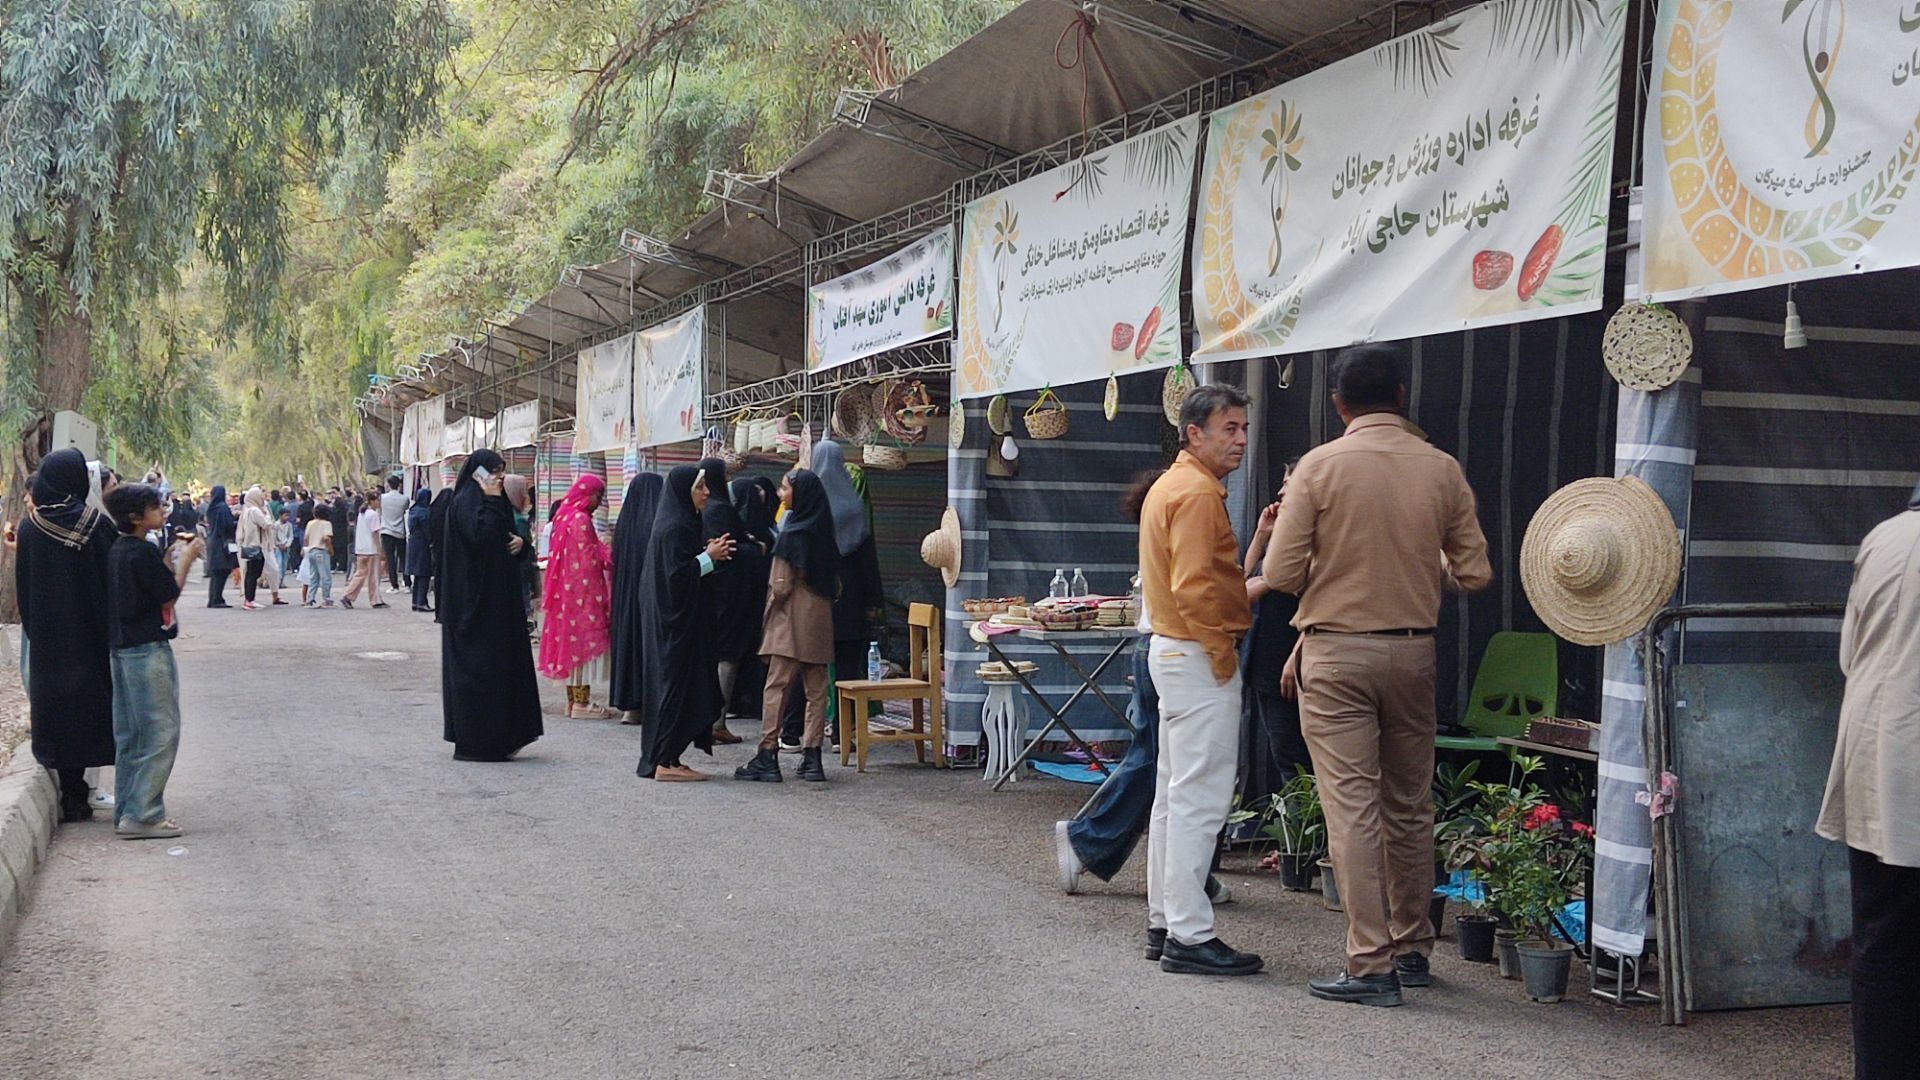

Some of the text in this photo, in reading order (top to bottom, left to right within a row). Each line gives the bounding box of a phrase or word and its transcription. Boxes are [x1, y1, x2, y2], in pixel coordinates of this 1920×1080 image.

[1331, 92, 1540, 200] غرفه اداره ورزش و جوانان
[1829, 150, 1871, 186] جشنواره
[1115, 209, 1146, 241] اقتصاد
[1148, 201, 1169, 236] غرفه
[1341, 178, 1510, 255] شهرستان حاجی آباد
[1078, 223, 1113, 260] مقاومتی
[1021, 242, 1043, 277] خانگی
[1089, 260, 1106, 281] فاطمه
[1107, 264, 1124, 285] بسیج
[1125, 252, 1151, 274] مقاومت
[893, 278, 914, 316] دانش
[916, 266, 935, 306] غرفه
